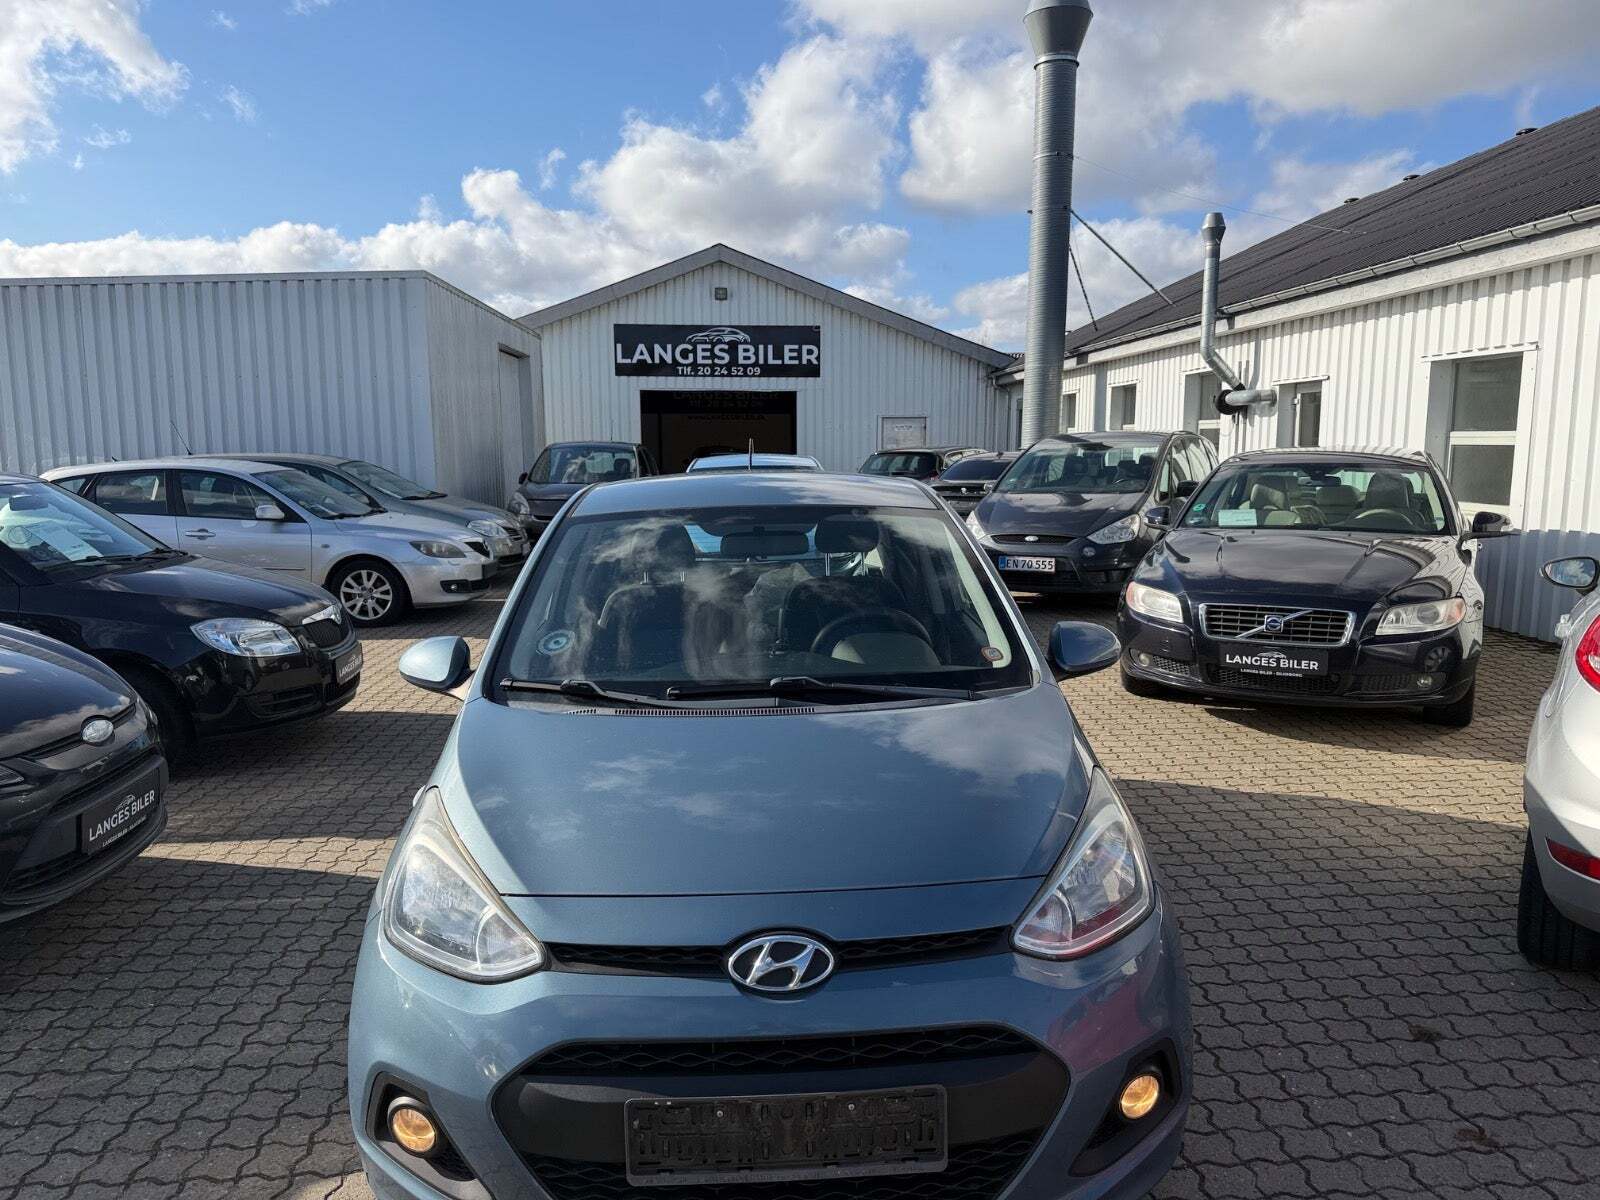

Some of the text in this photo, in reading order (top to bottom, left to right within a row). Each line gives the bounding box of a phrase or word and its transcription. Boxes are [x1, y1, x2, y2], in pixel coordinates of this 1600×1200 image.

[616, 343, 819, 365] LANGES BILER
[676, 366, 761, 376] Tlf. 20 24 52 09
[1006, 559, 1054, 570] EN 70 555
[1225, 654, 1319, 670] LANGES BILER
[89, 806, 130, 842] LANGES
[131, 789, 155, 816] BILER
